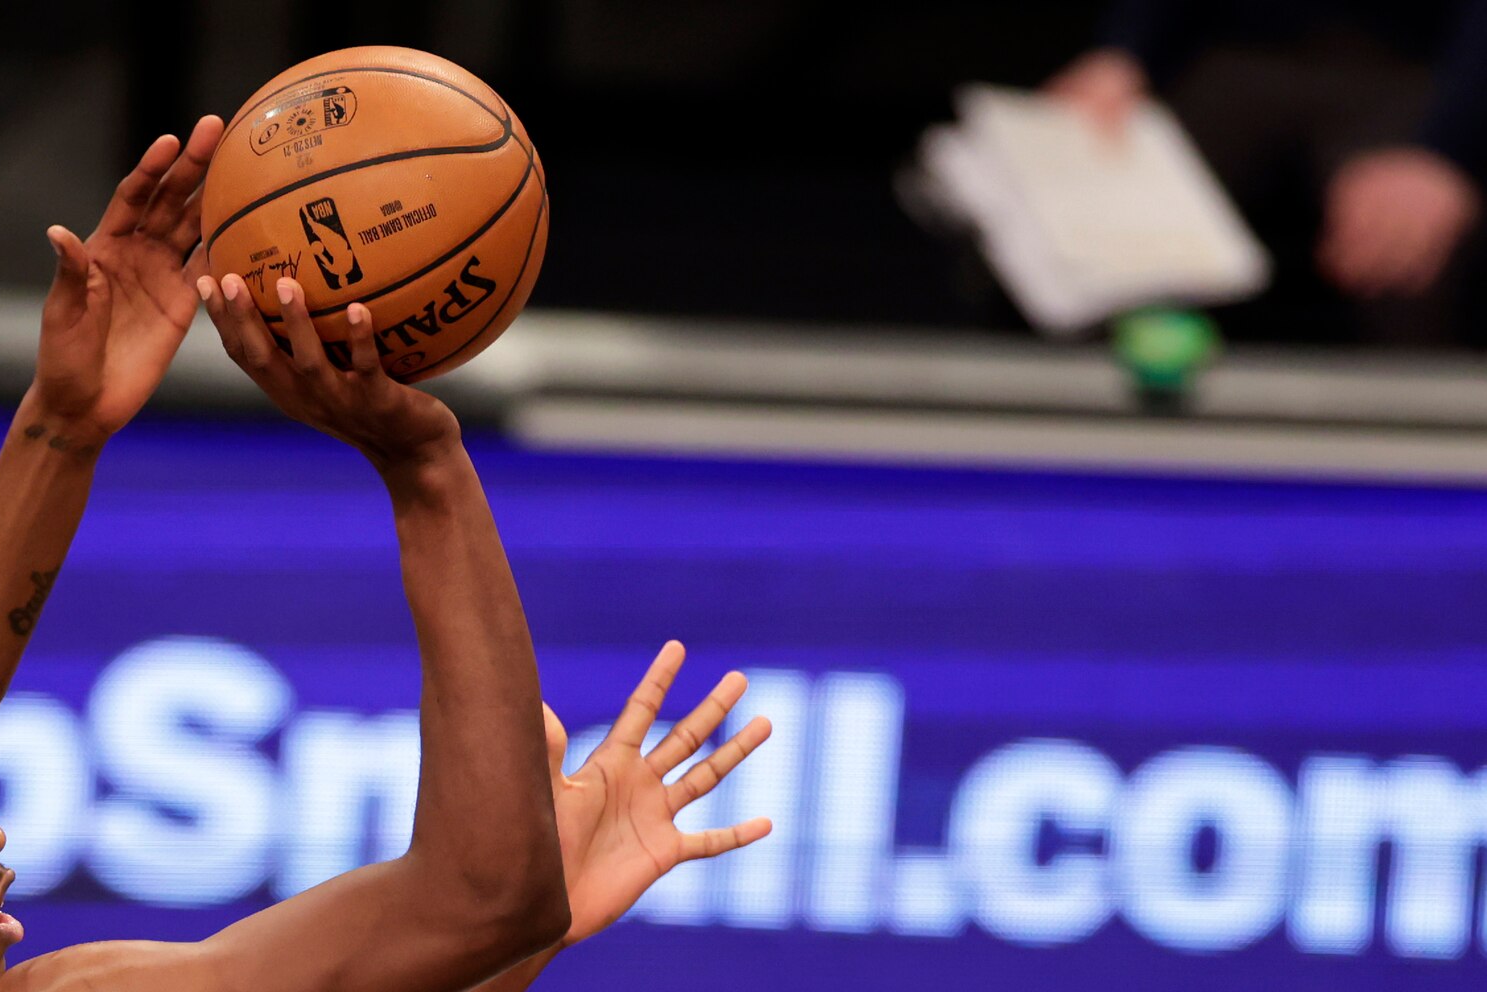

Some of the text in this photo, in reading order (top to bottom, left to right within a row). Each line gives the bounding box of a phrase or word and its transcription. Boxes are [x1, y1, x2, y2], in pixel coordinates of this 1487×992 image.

[311, 199, 334, 221] NBA
[358, 203, 438, 246] OFFICIAL GAME BALL
